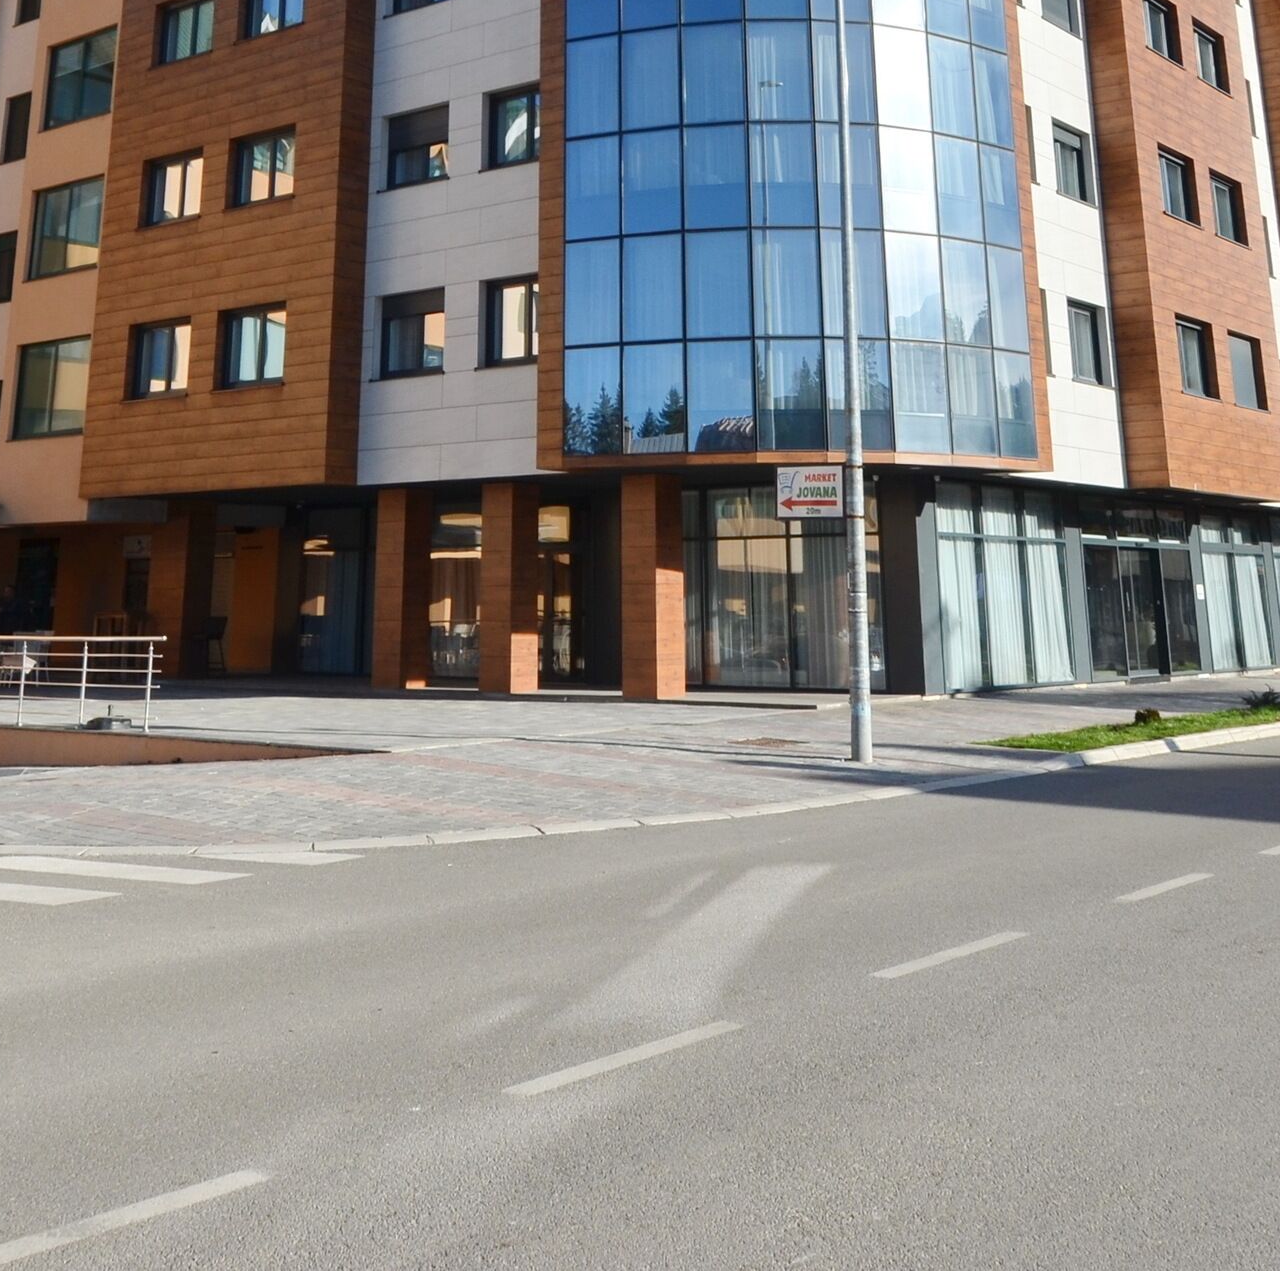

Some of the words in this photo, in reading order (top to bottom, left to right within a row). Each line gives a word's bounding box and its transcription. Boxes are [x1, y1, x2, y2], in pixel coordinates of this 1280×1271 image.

[804, 473, 837, 483] MARKET
[796, 486, 838, 498] JOVANA
[806, 507, 821, 515] 20m
